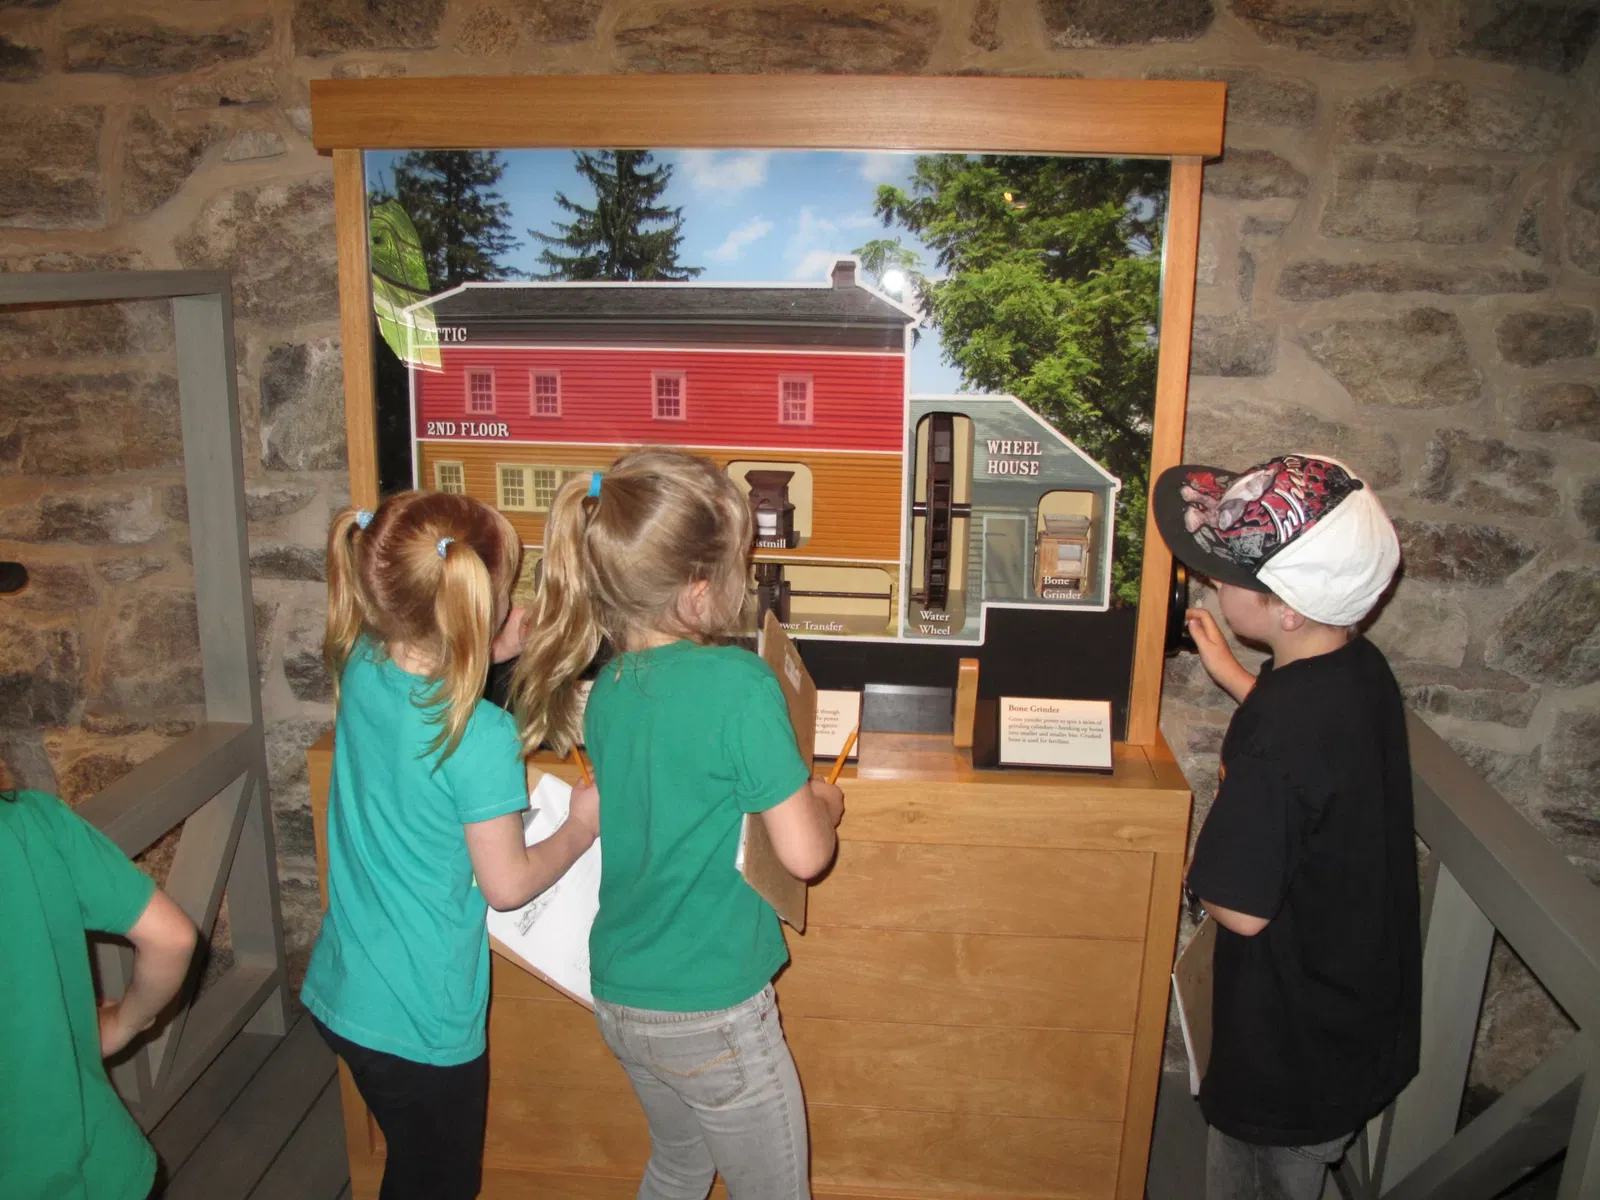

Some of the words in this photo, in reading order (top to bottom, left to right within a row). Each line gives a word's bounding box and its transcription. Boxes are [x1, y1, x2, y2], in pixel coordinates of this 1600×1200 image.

[424, 327, 467, 342] ATTIC
[427, 421, 456, 436] 2ND
[460, 422, 509, 437] FLOOR
[986, 440, 1042, 455] WHEEL
[987, 460, 1039, 475] HOUSE
[755, 538, 786, 549] istmill
[1043, 575, 1070, 586] Bone
[1043, 589, 1082, 600] Grinder
[919, 610, 950, 622] Water
[802, 620, 844, 632] Transfer
[918, 624, 950, 636] Wheel
[1008, 704, 1028, 712] Bone
[1029, 705, 1060, 714] Grinder
